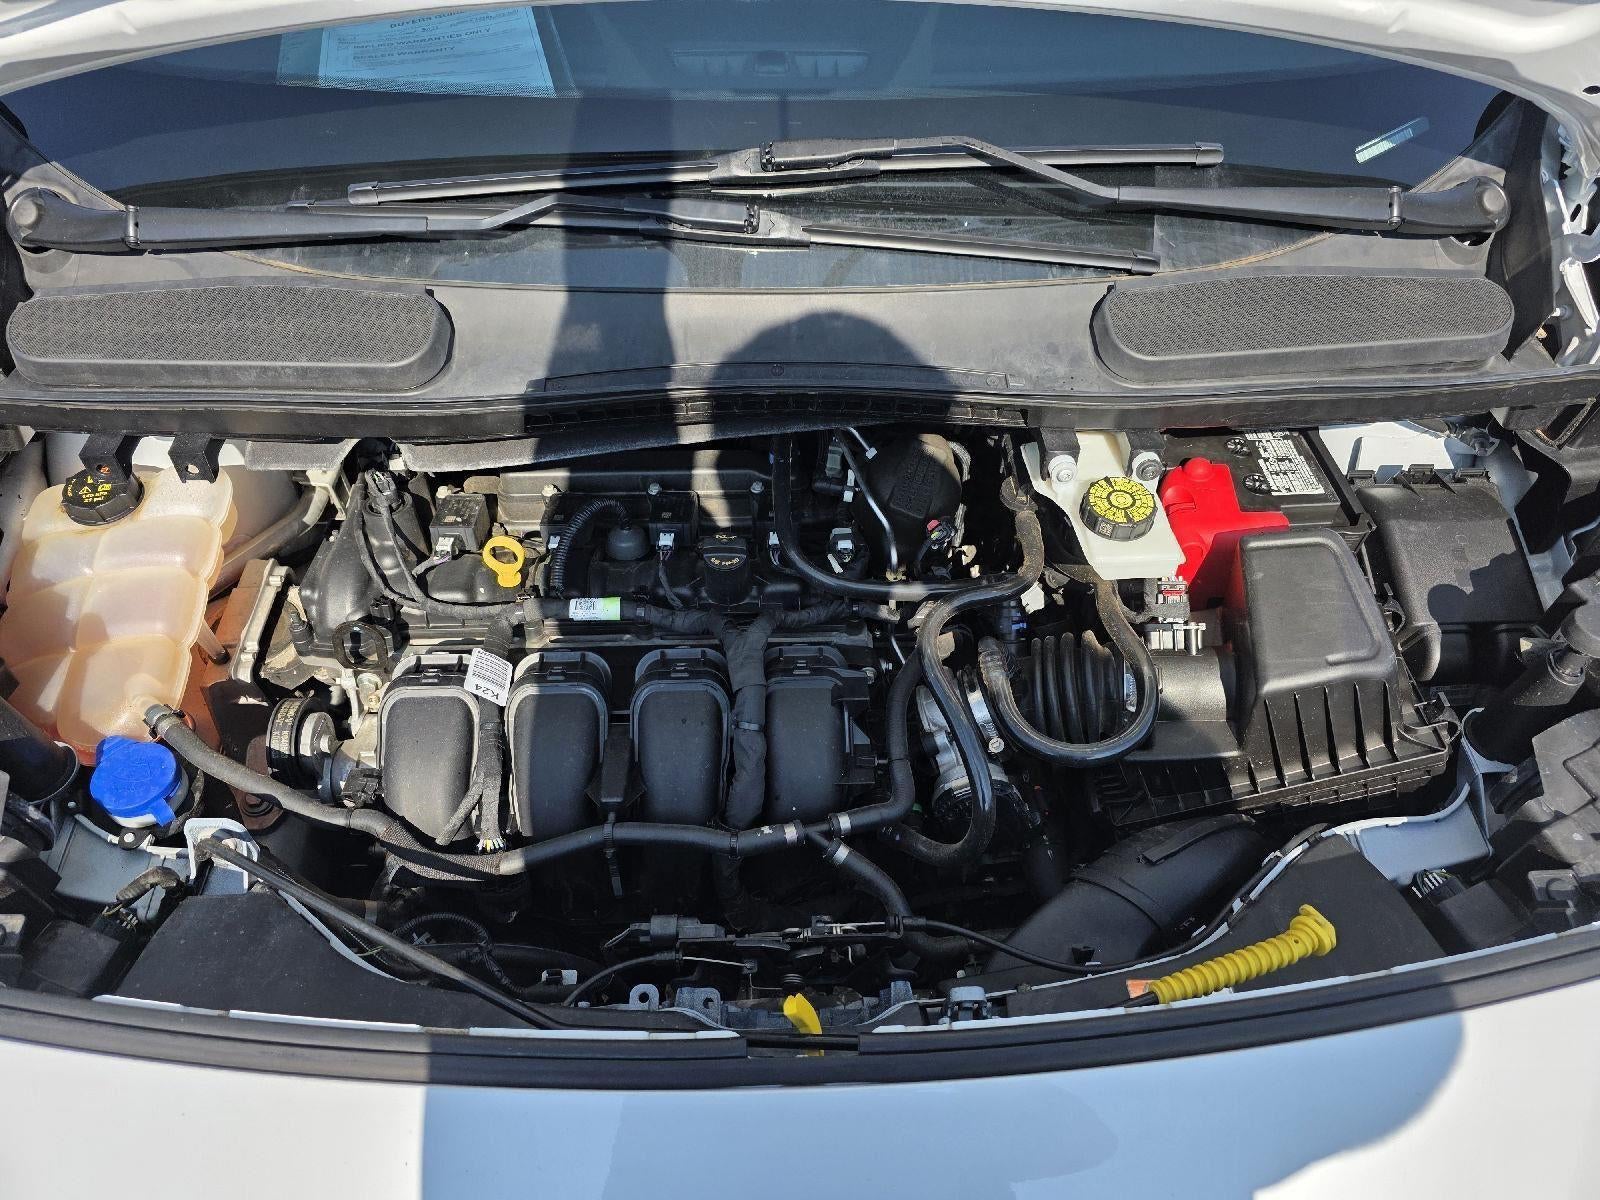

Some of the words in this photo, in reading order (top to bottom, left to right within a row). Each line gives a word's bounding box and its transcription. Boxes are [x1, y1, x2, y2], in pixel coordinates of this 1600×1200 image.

[397, 33, 463, 45] WARRANTIES
[465, 28, 491, 36] ONLY
[397, 46, 456, 56] WARRANTY
[475, 683, 499, 700] K24
